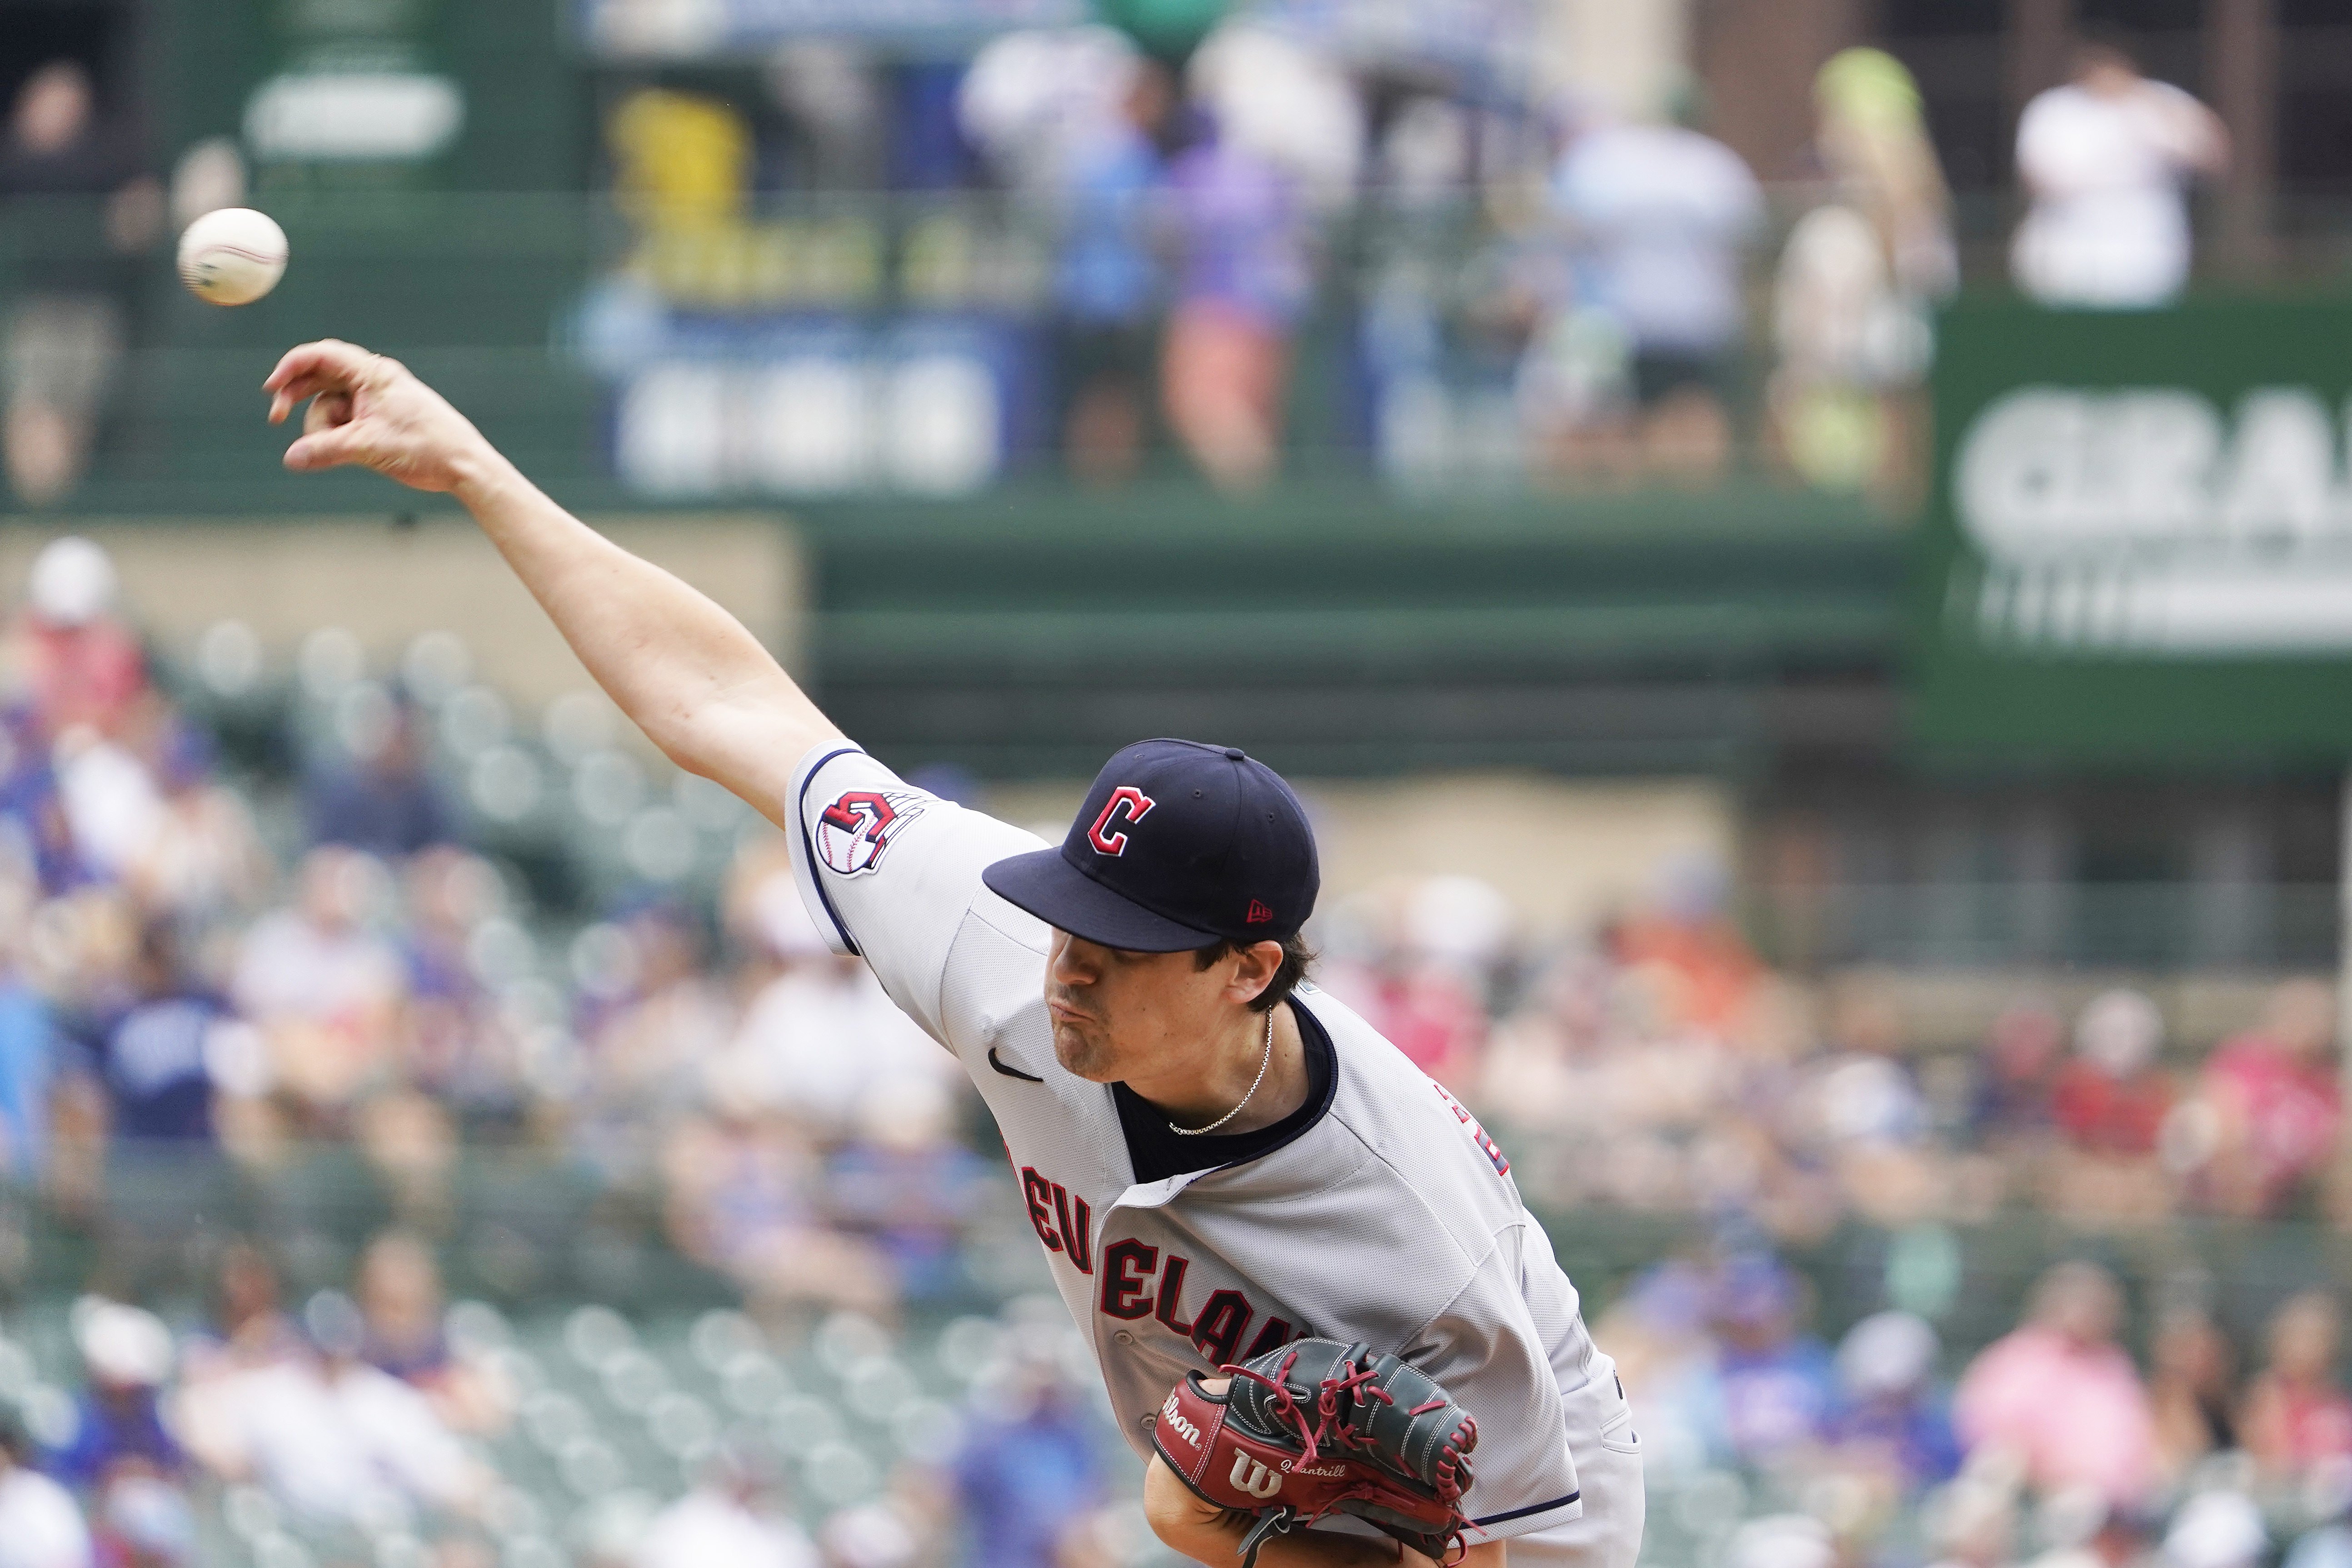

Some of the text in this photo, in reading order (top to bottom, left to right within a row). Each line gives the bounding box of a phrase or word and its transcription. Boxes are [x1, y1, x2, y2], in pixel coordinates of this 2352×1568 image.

[1952, 390, 2352, 550] GRA
[1088, 786, 1156, 857] C
[1229, 1447, 1283, 1499] W
